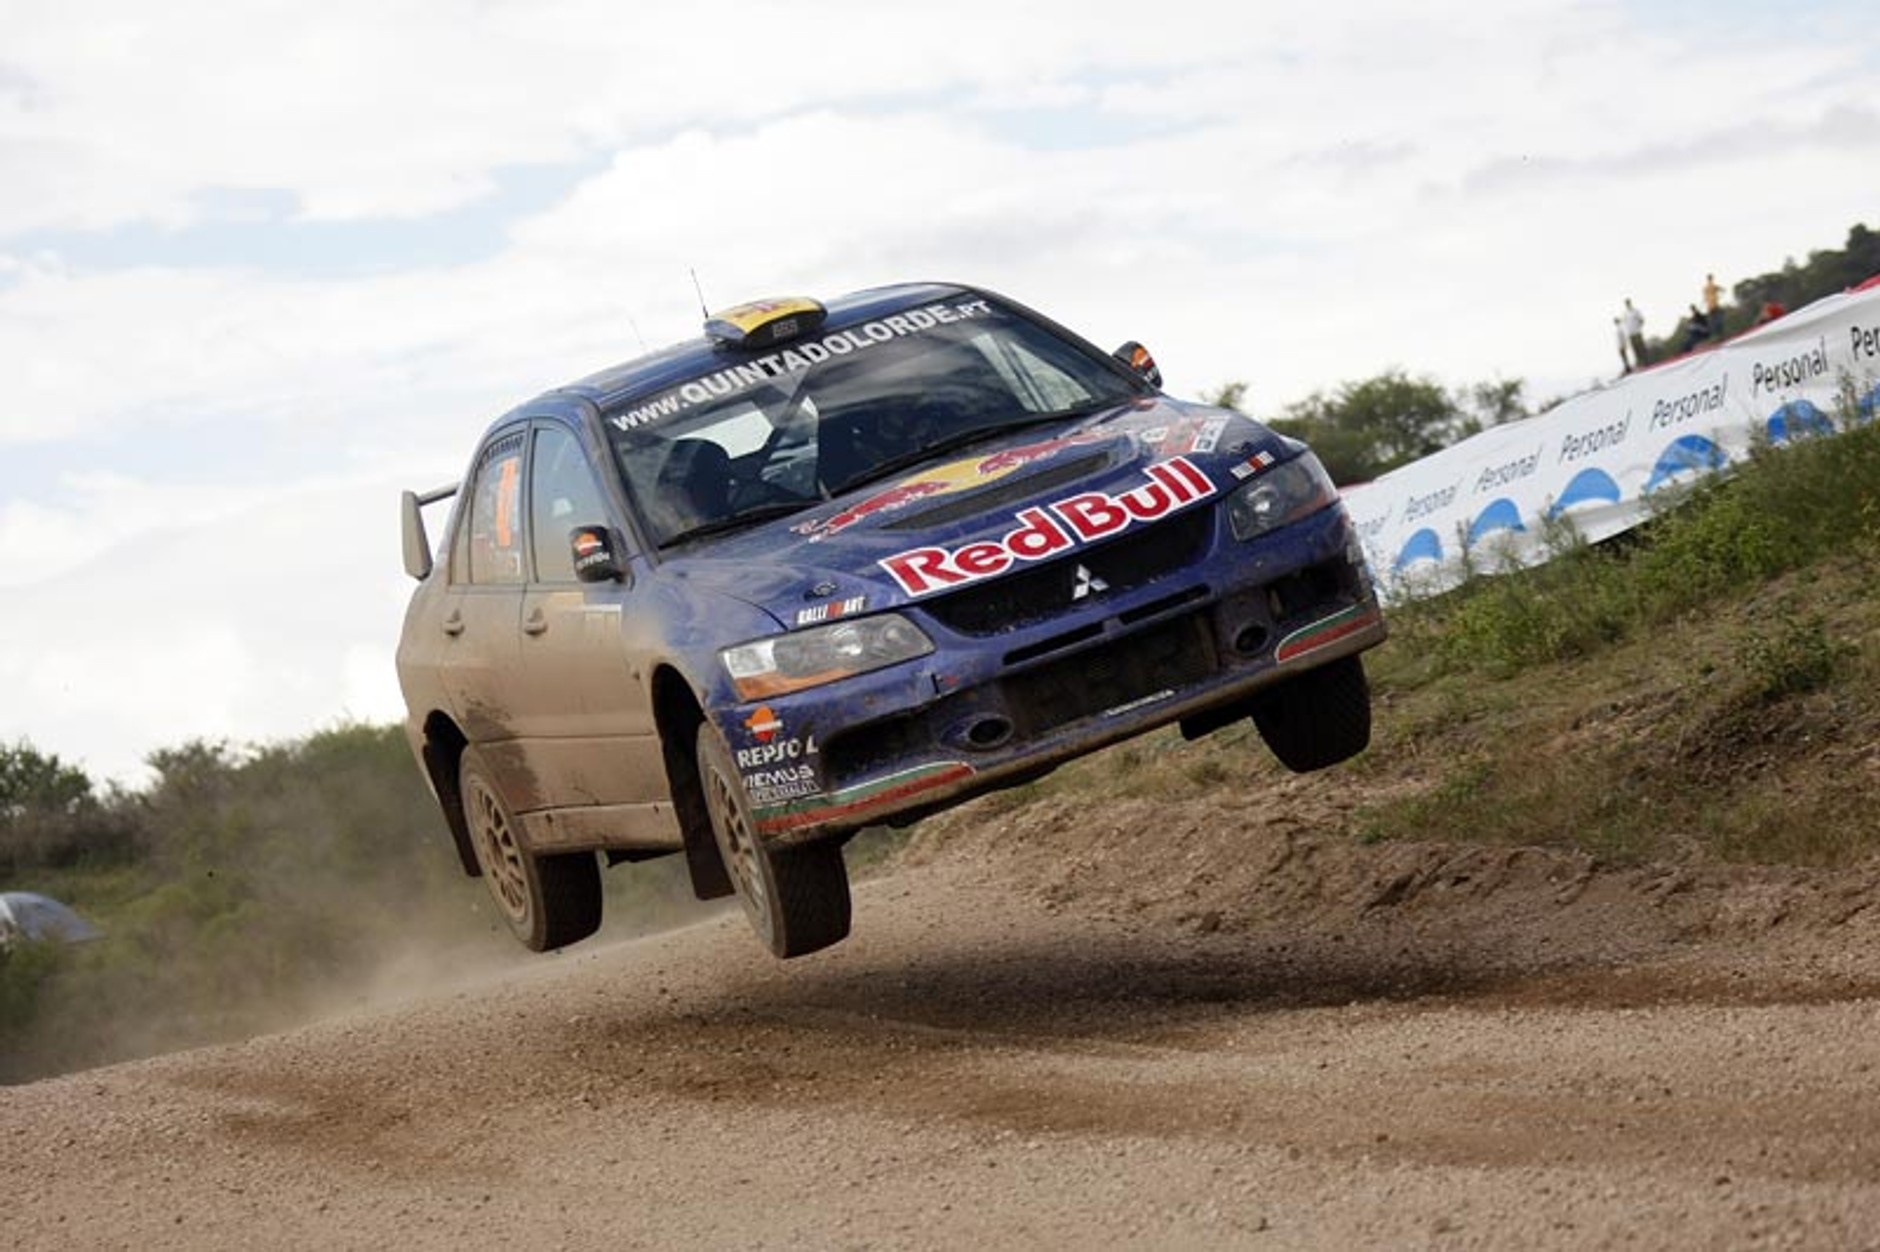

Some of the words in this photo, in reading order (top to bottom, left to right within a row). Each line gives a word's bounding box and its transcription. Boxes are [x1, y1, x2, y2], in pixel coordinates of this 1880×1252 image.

[1752, 335, 1828, 397] Personal
[1650, 373, 1728, 431] Personal
[1559, 410, 1632, 464] Personal
[877, 505, 1075, 596] Red
[1050, 455, 1217, 542] Bull
[737, 735, 819, 769] REPSOL
